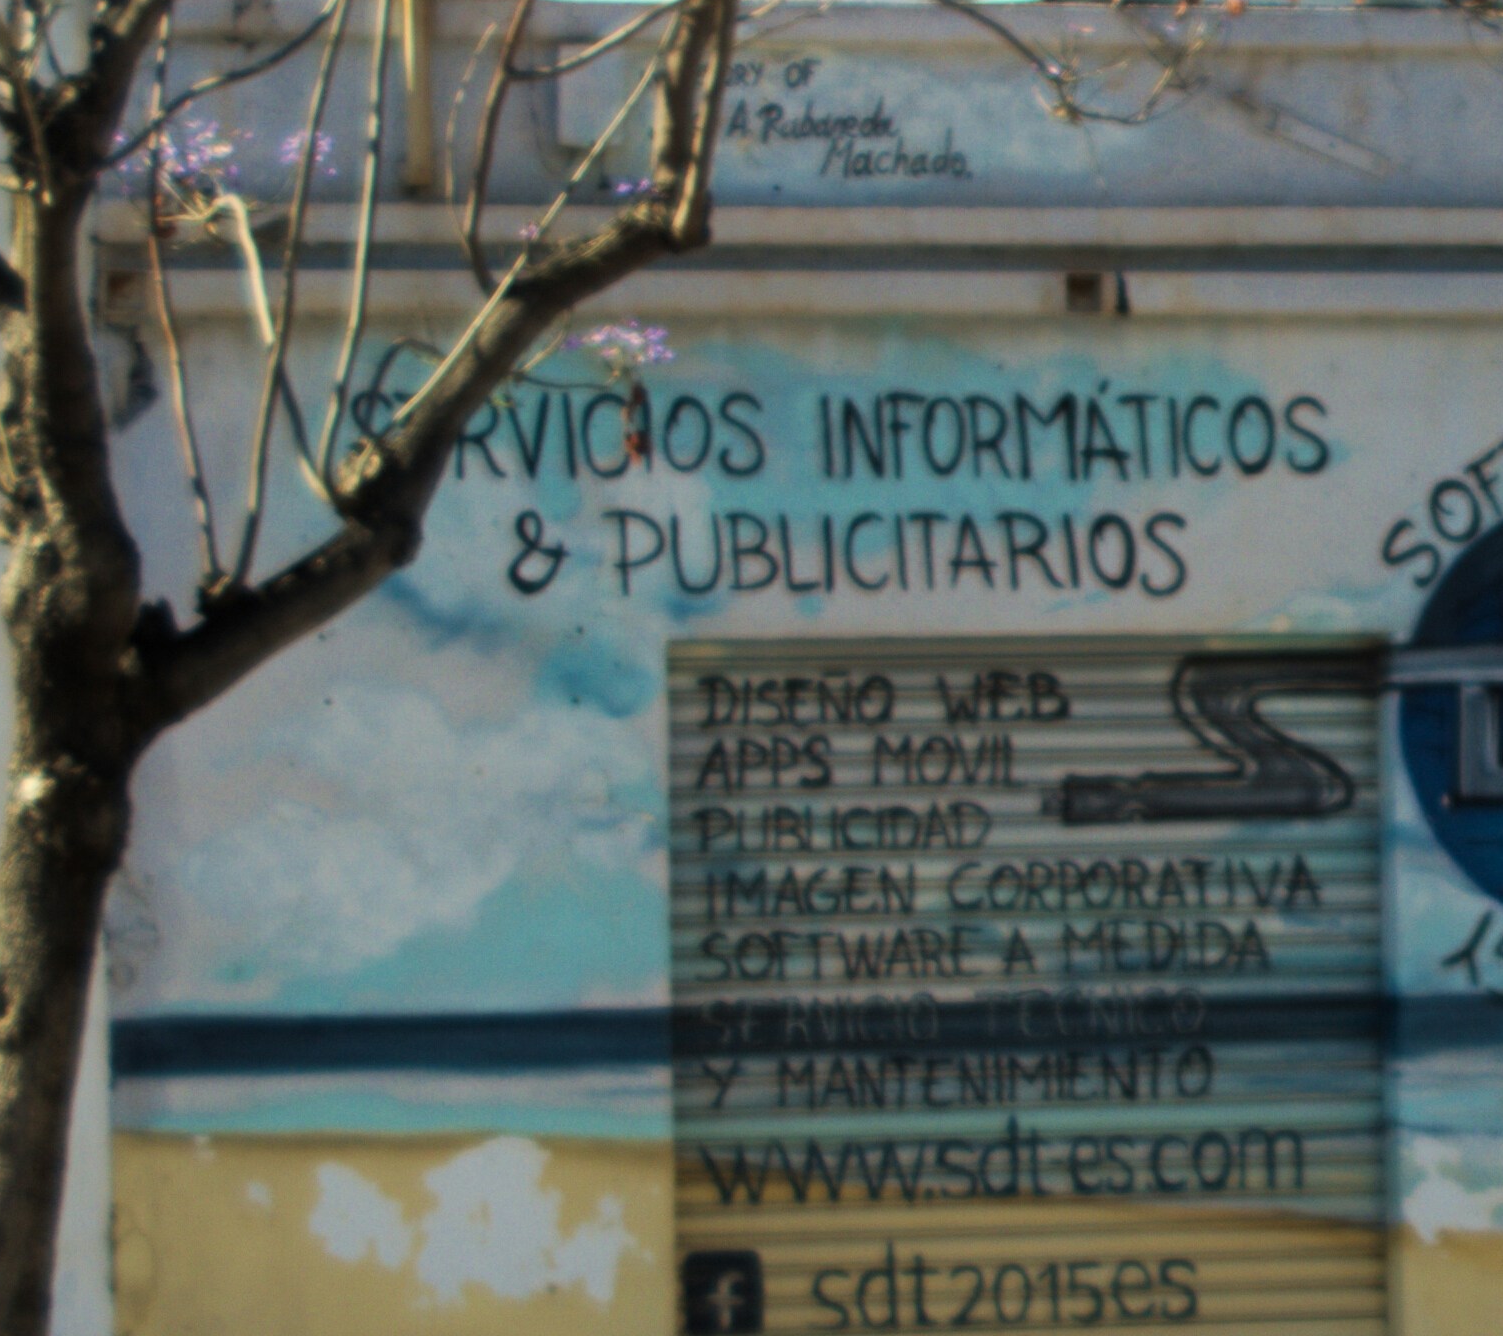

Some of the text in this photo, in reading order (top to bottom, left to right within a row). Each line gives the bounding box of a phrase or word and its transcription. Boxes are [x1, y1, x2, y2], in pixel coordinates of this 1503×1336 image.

[817, 381, 1331, 482] INFORMÁTICOS
[507, 510, 1189, 598] & PUBLICITARIOS
[699, 671, 1071, 728] DISEÑO WEB
[697, 736, 833, 790] APPS
[699, 802, 991, 852] PUBLICIDAD
[703, 852, 1325, 922] IMAGEN CORPORATIVA
[701, 920, 1273, 982] SOFTWARE A MEDIDA
[703, 1044, 1215, 1110] Y MANTENIMIENTO
